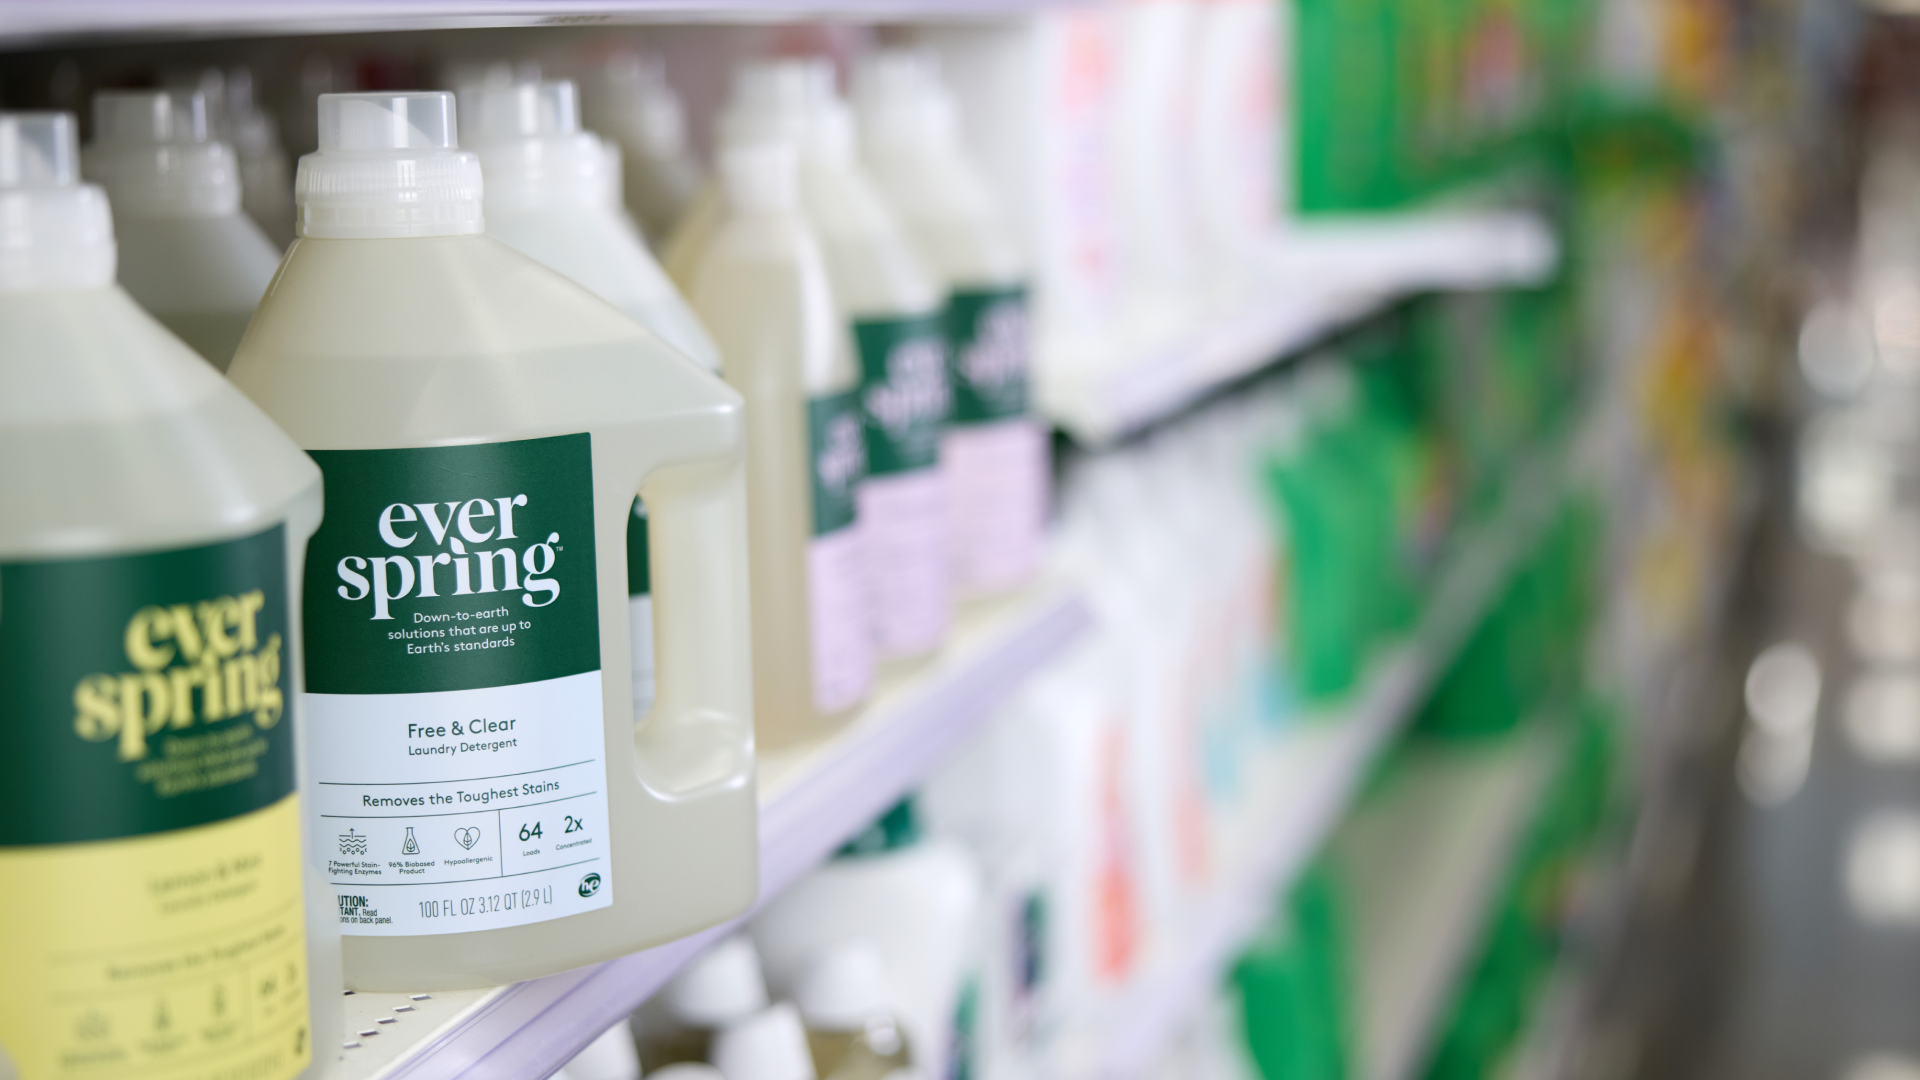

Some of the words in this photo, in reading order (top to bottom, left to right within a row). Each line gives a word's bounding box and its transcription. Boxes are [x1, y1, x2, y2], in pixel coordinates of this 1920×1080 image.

[378, 494, 528, 548] ever
[337, 532, 561, 620] spring
[413, 606, 509, 623] Down-to-earth
[124, 589, 265, 671] ever
[387, 628, 446, 640] solutions
[448, 625, 477, 637] that
[479, 625, 499, 634] are
[501, 623, 517, 634] up
[518, 620, 531, 630] to
[454, 636, 515, 652] standards
[73, 632, 284, 762] spring
[408, 723, 446, 738] Free
[451, 720, 465, 736] &
[468, 717, 517, 734] Clear
[408, 743, 457, 756] Laundry
[460, 737, 518, 753] Detergent
[363, 794, 425, 807] Removes
[429, 793, 453, 805] the
[457, 786, 519, 804] Toughest
[522, 780, 560, 796] Stains
[518, 820, 544, 842] 64
[564, 815, 584, 834] 2x
[522, 848, 541, 857] Loads
[555, 838, 593, 851] Concentrated
[404, 860, 436, 868] Biobased
[444, 855, 494, 867] Hypoallergenic
[328, 867, 353, 876] Fighting
[354, 868, 382, 876] Enzymes
[399, 867, 426, 875] Product
[418, 900, 439, 918] 100
[443, 899, 458, 917] FL
[460, 897, 476, 916] OZ
[478, 894, 501, 914] 3.12
[503, 892, 518, 911] QT
[521, 888, 540, 909] (2.9
[543, 884, 553, 905] L)
[359, 915, 374, 925] back
[374, 915, 394, 926] panel.
[362, 908, 378, 917] Read
